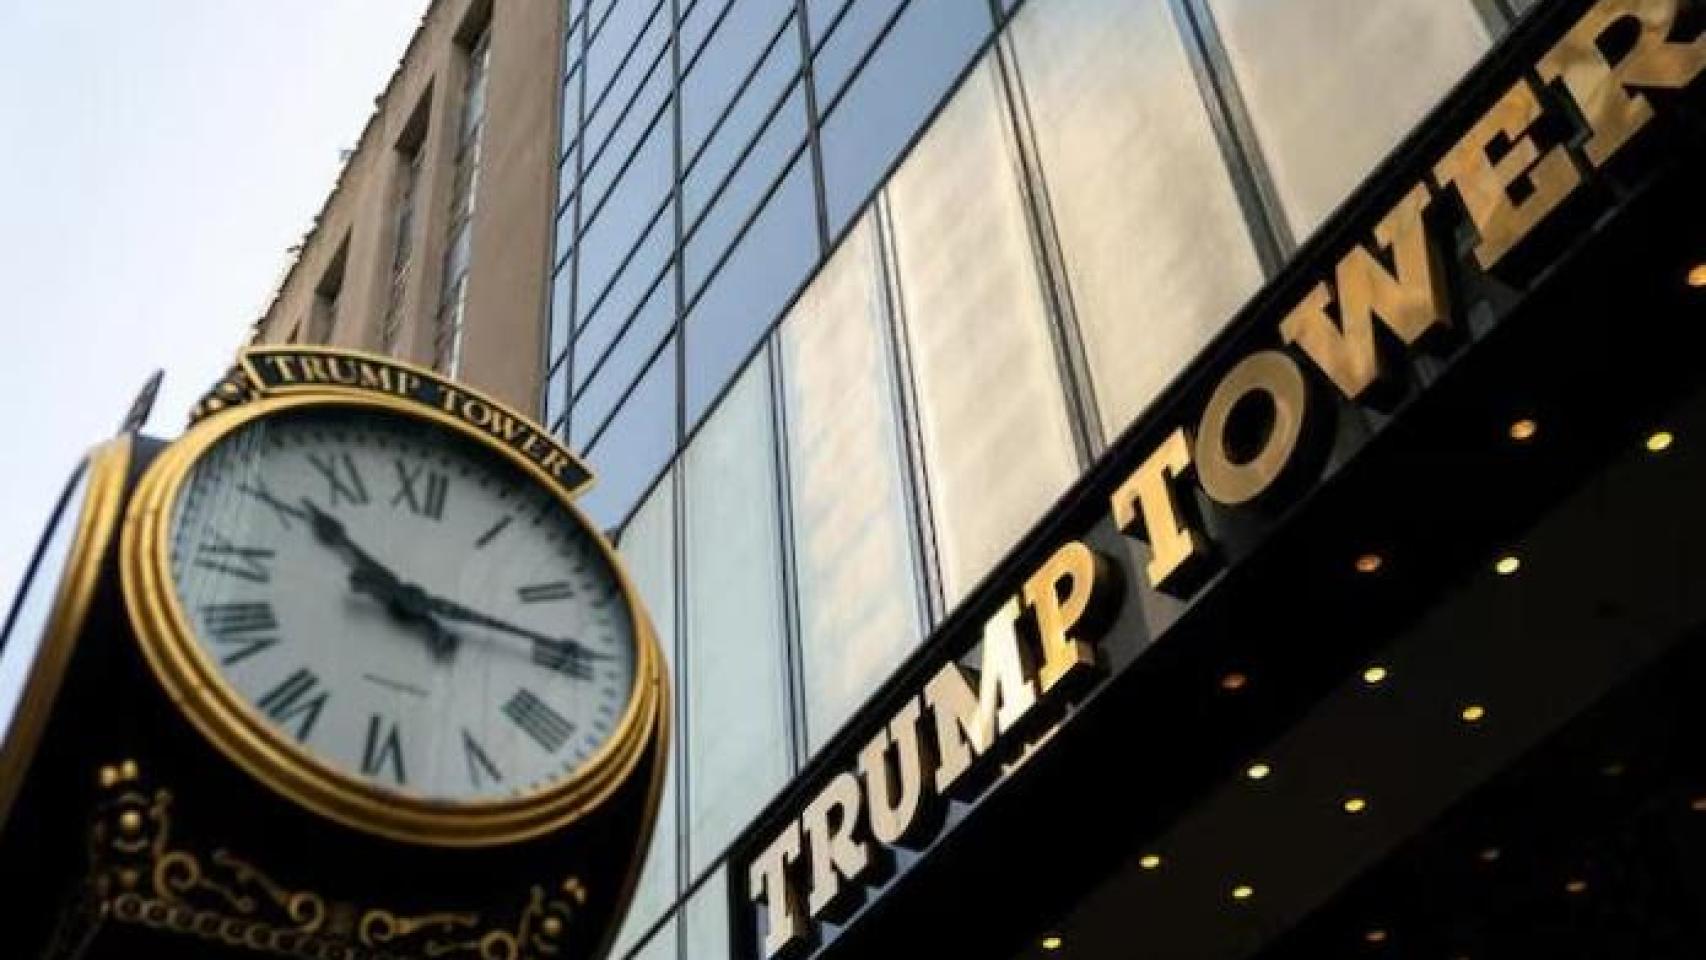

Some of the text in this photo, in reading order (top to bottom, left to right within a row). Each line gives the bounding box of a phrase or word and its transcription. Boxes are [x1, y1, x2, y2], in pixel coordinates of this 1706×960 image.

[264, 355, 568, 477] TRUMP TOWER
[307, 452, 370, 505] XI
[390, 458, 449, 520] XII
[750, 0, 1706, 958] TRUMP TOWER
[256, 668, 331, 743] VII
[361, 713, 407, 785] VI
[462, 727, 502, 787] V
